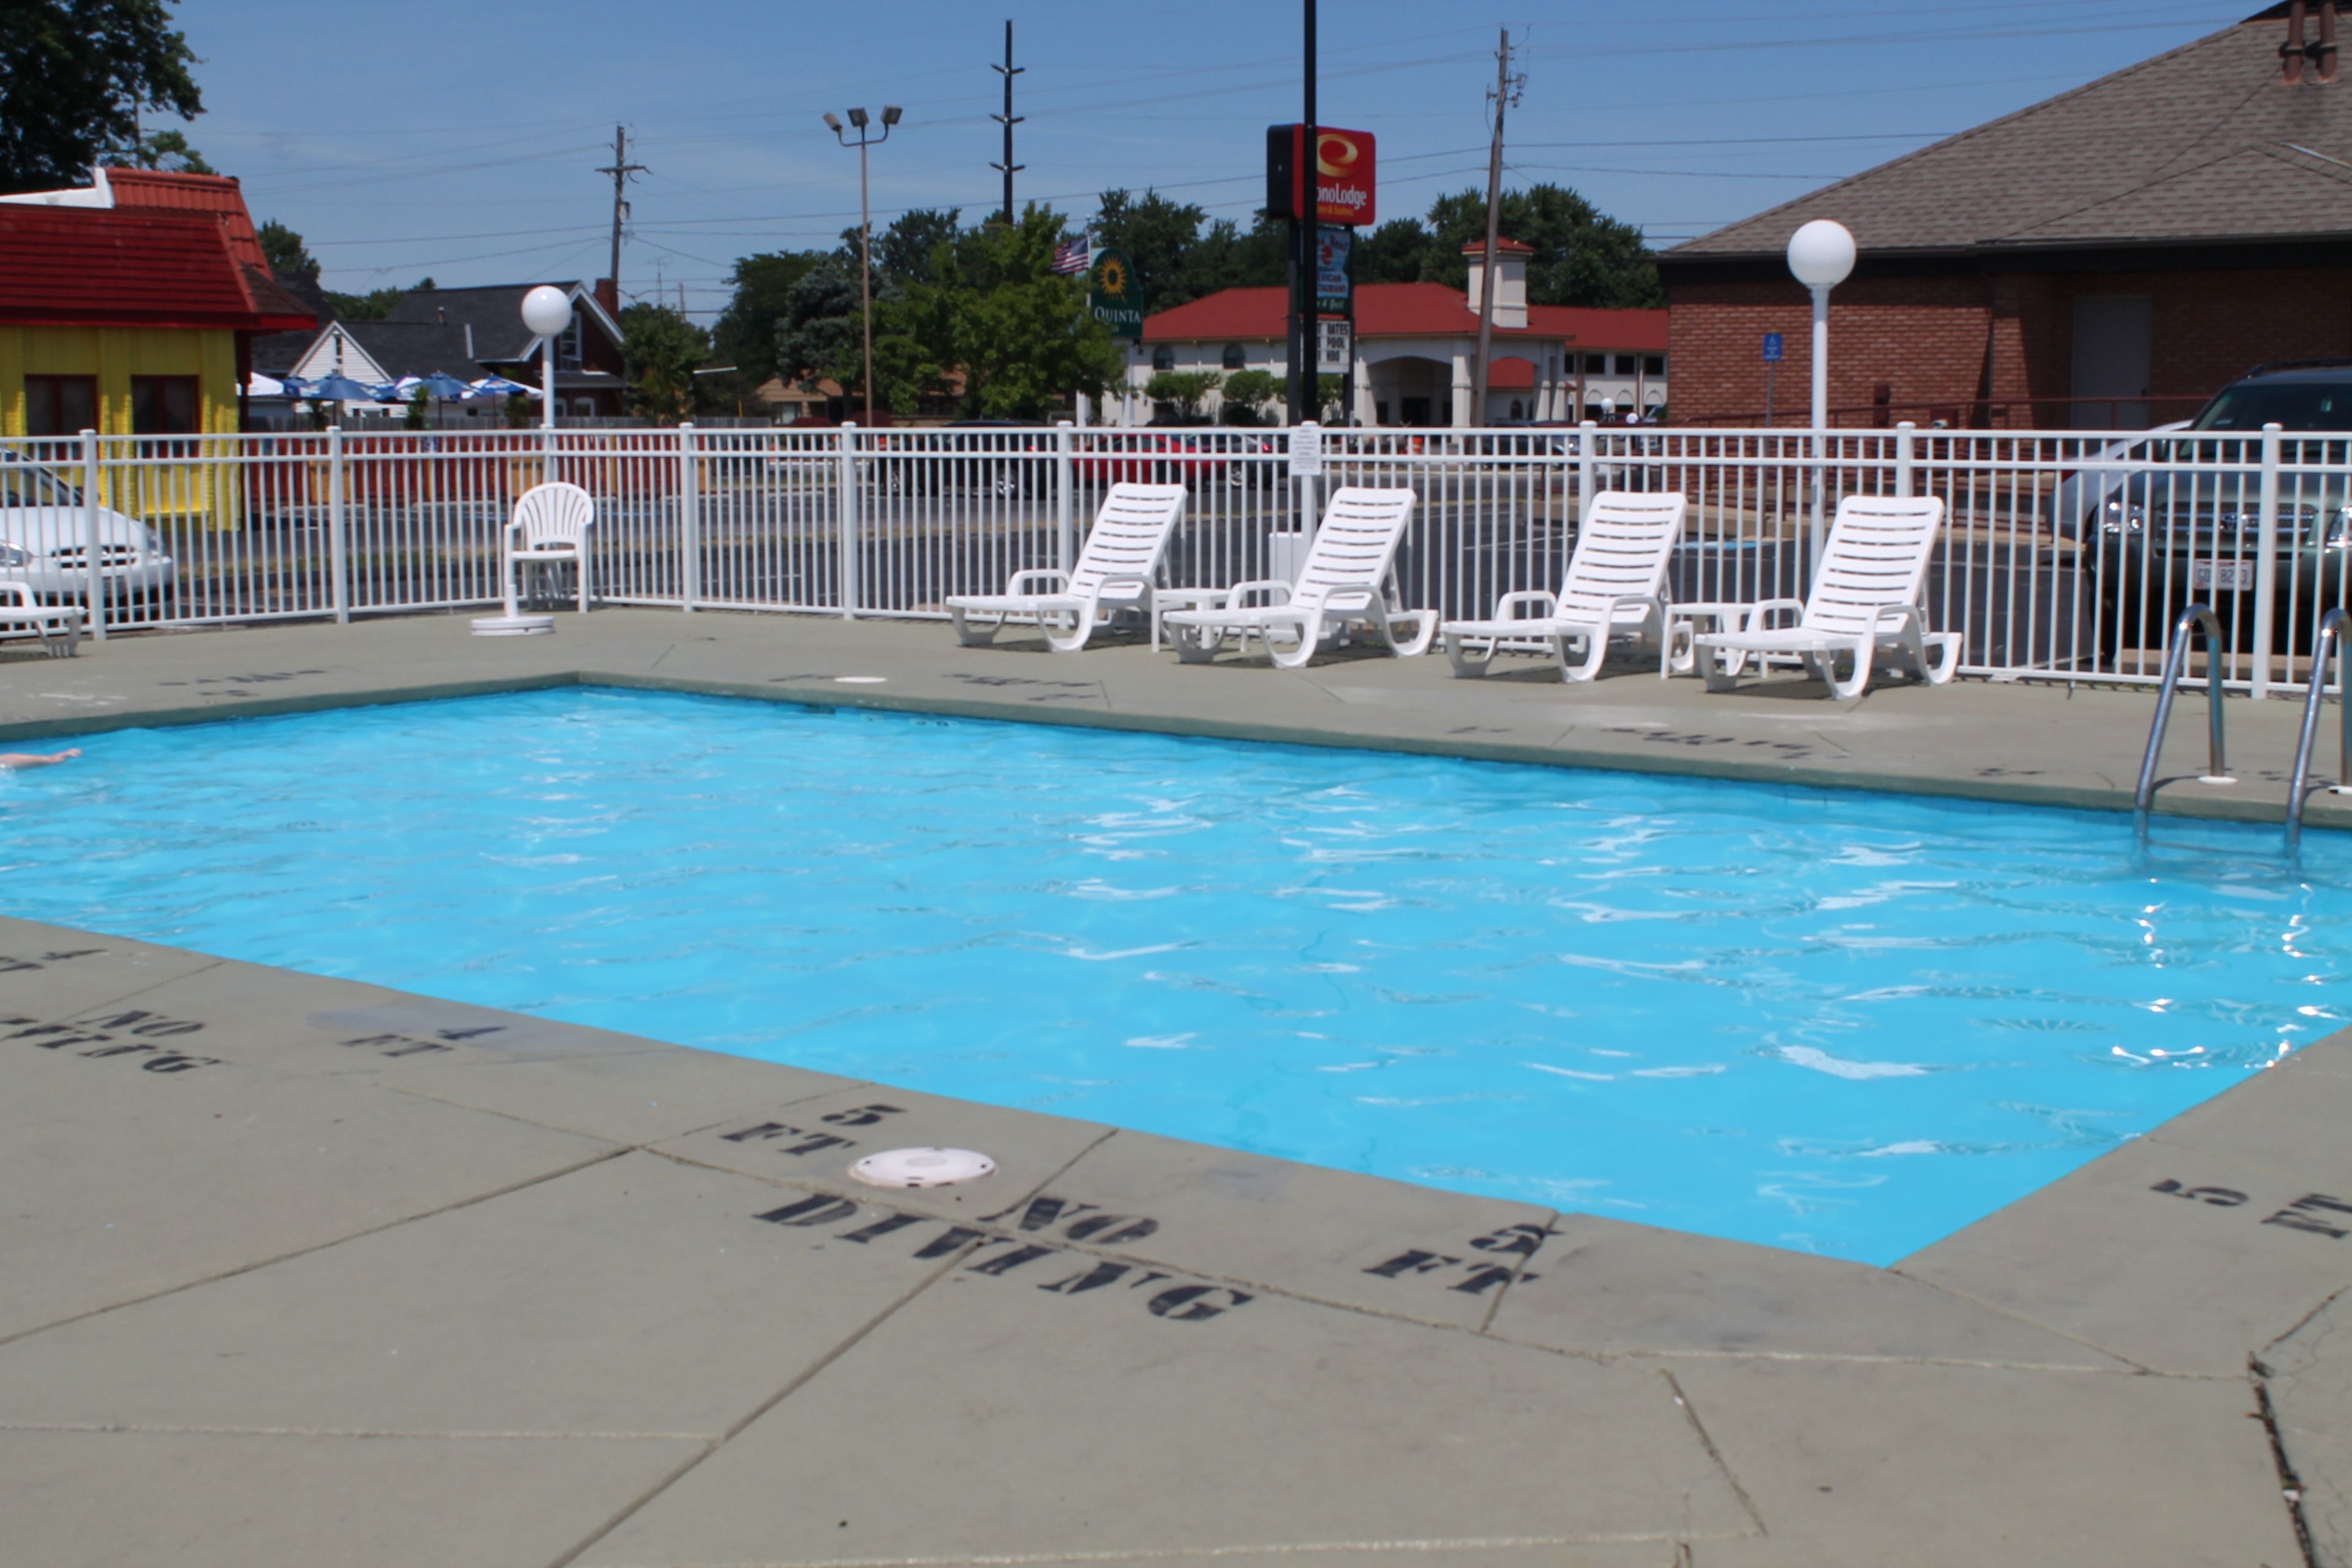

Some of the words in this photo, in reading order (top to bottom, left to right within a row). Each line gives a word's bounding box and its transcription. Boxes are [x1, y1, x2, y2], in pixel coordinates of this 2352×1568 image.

[1327, 323, 1349, 335] RATES
[1327, 336, 1345, 349] POOL
[718, 1123, 858, 1155] FT
[979, 1197, 1160, 1244] NO
[752, 1194, 1255, 1321] DIVING
[1361, 1249, 1541, 1295] FT
